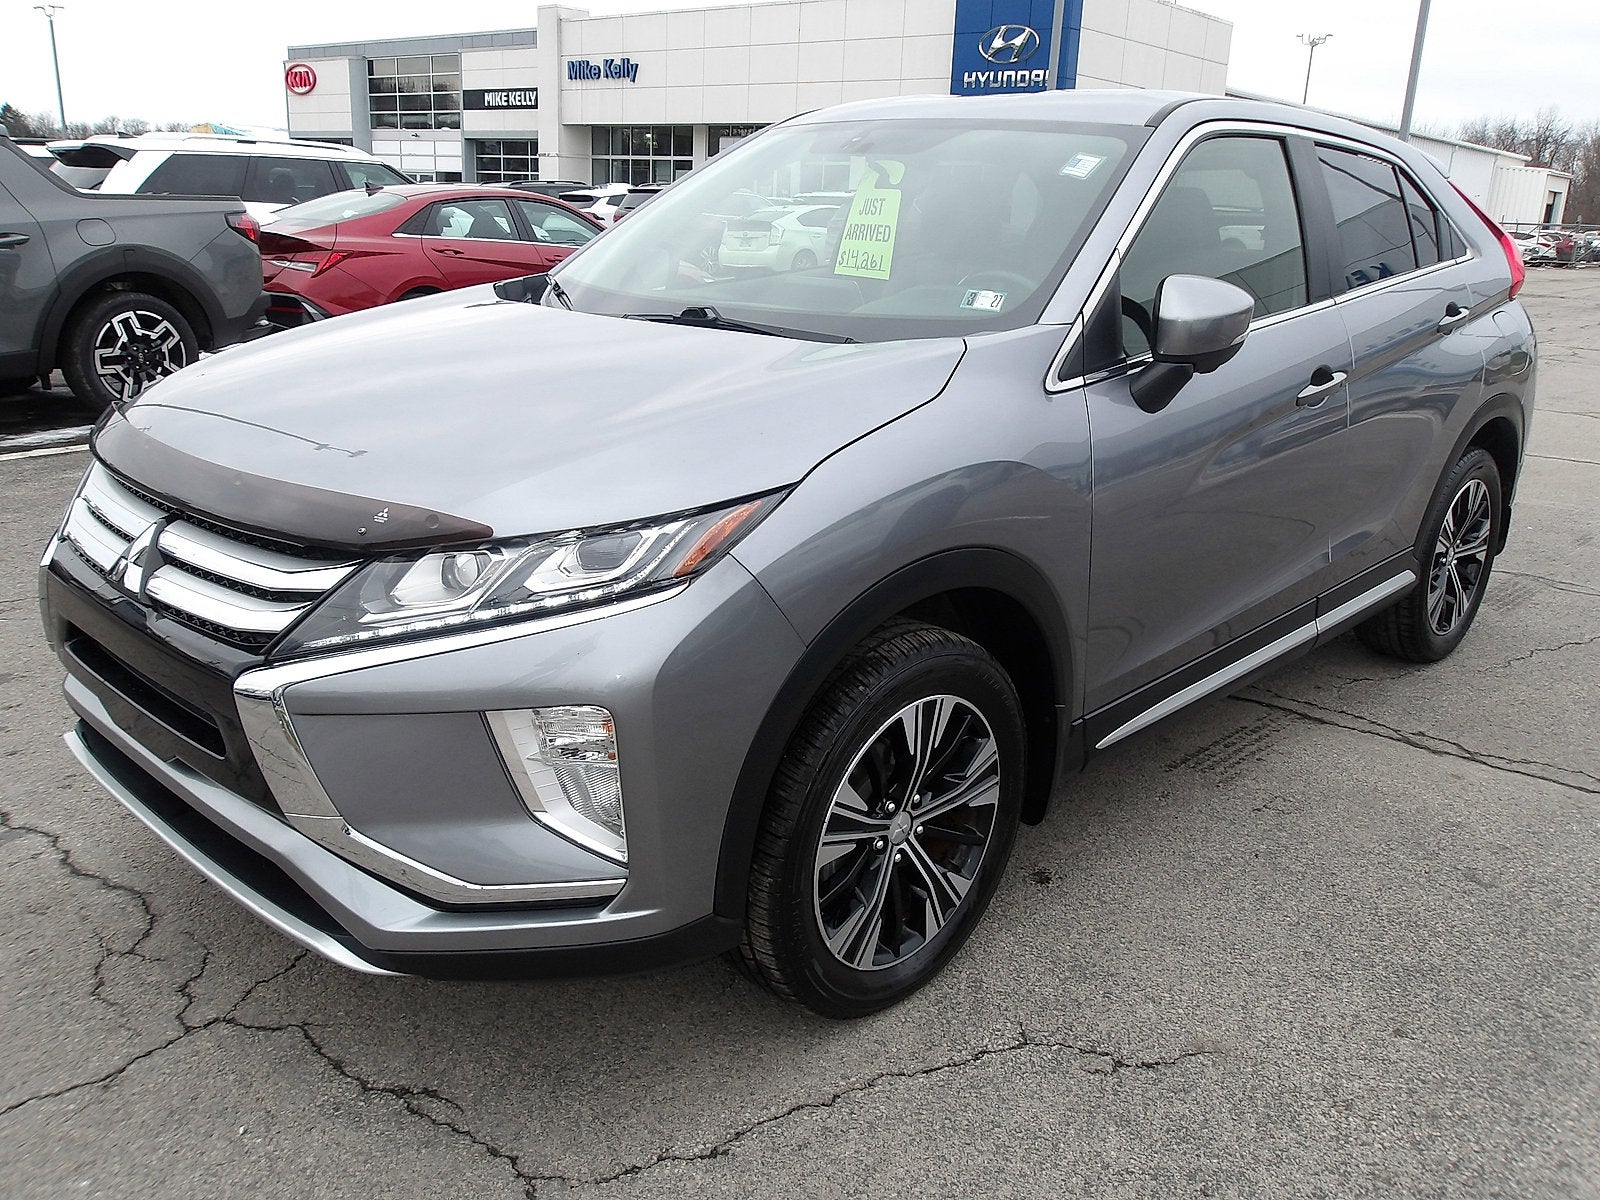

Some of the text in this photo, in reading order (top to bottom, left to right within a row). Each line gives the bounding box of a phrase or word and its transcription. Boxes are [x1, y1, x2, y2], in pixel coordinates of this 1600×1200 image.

[289, 70, 312, 88] KIA
[567, 57, 639, 83] Mike Kelly
[484, 91, 536, 107] MIKE KELLY
[858, 198, 886, 216] JUST
[844, 223, 891, 242] ARRIVED
[838, 248, 885, 272] $14,261
[990, 294, 1004, 308] 27
